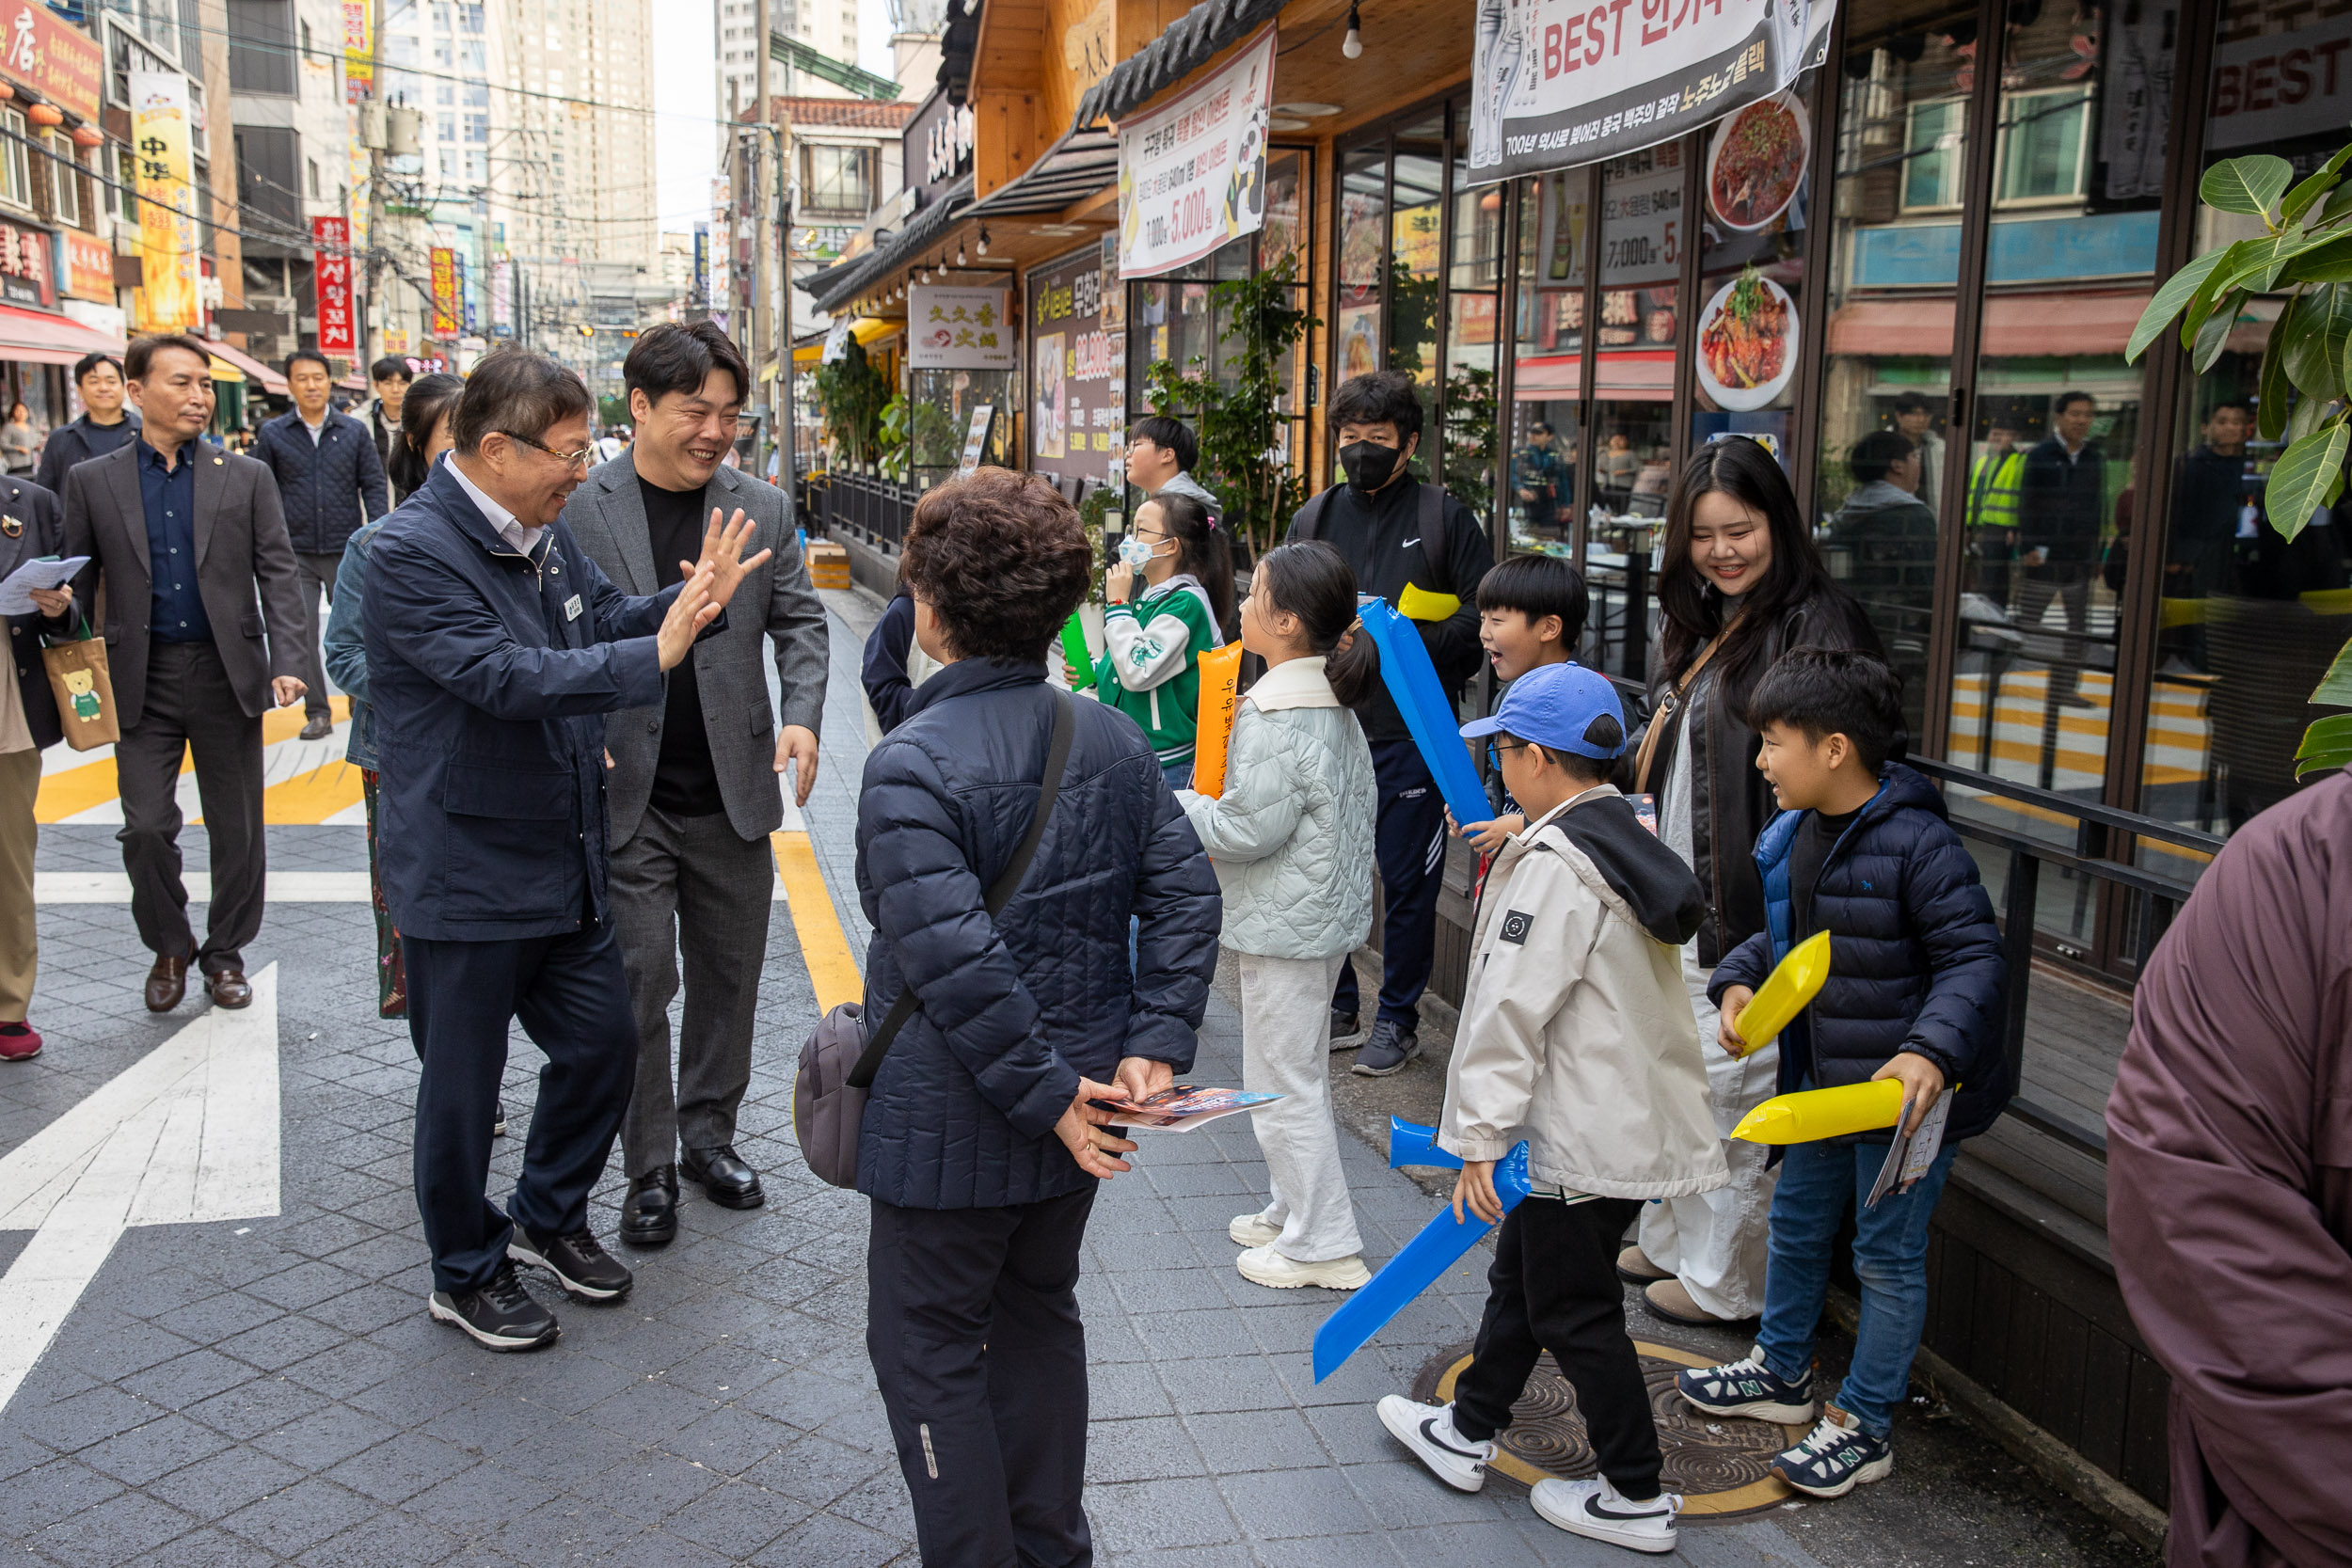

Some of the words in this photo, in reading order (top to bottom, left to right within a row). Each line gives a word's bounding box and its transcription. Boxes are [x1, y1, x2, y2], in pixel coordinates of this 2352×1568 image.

[1544, 0, 1632, 81] BEST
[2208, 37, 2351, 118] BEST
[1176, 114, 1190, 143] 특별
[1191, 103, 1207, 139] 할인
[1206, 87, 1231, 127] 이벤트
[1505, 134, 1537, 156] 700년
[1537, 128, 1569, 152] 역사로
[1570, 119, 1600, 146] 빚어진
[1600, 112, 1622, 138] 중국
[1624, 101, 1654, 129] 백주의
[1656, 92, 1680, 120] 걸작
[1195, 149, 1208, 178] 할인
[1208, 138, 1228, 170] 이벤트
[929, 302, 998, 327] 久久香
[1739, 1380, 1763, 1397] N
[1837, 1447, 1861, 1467] N
